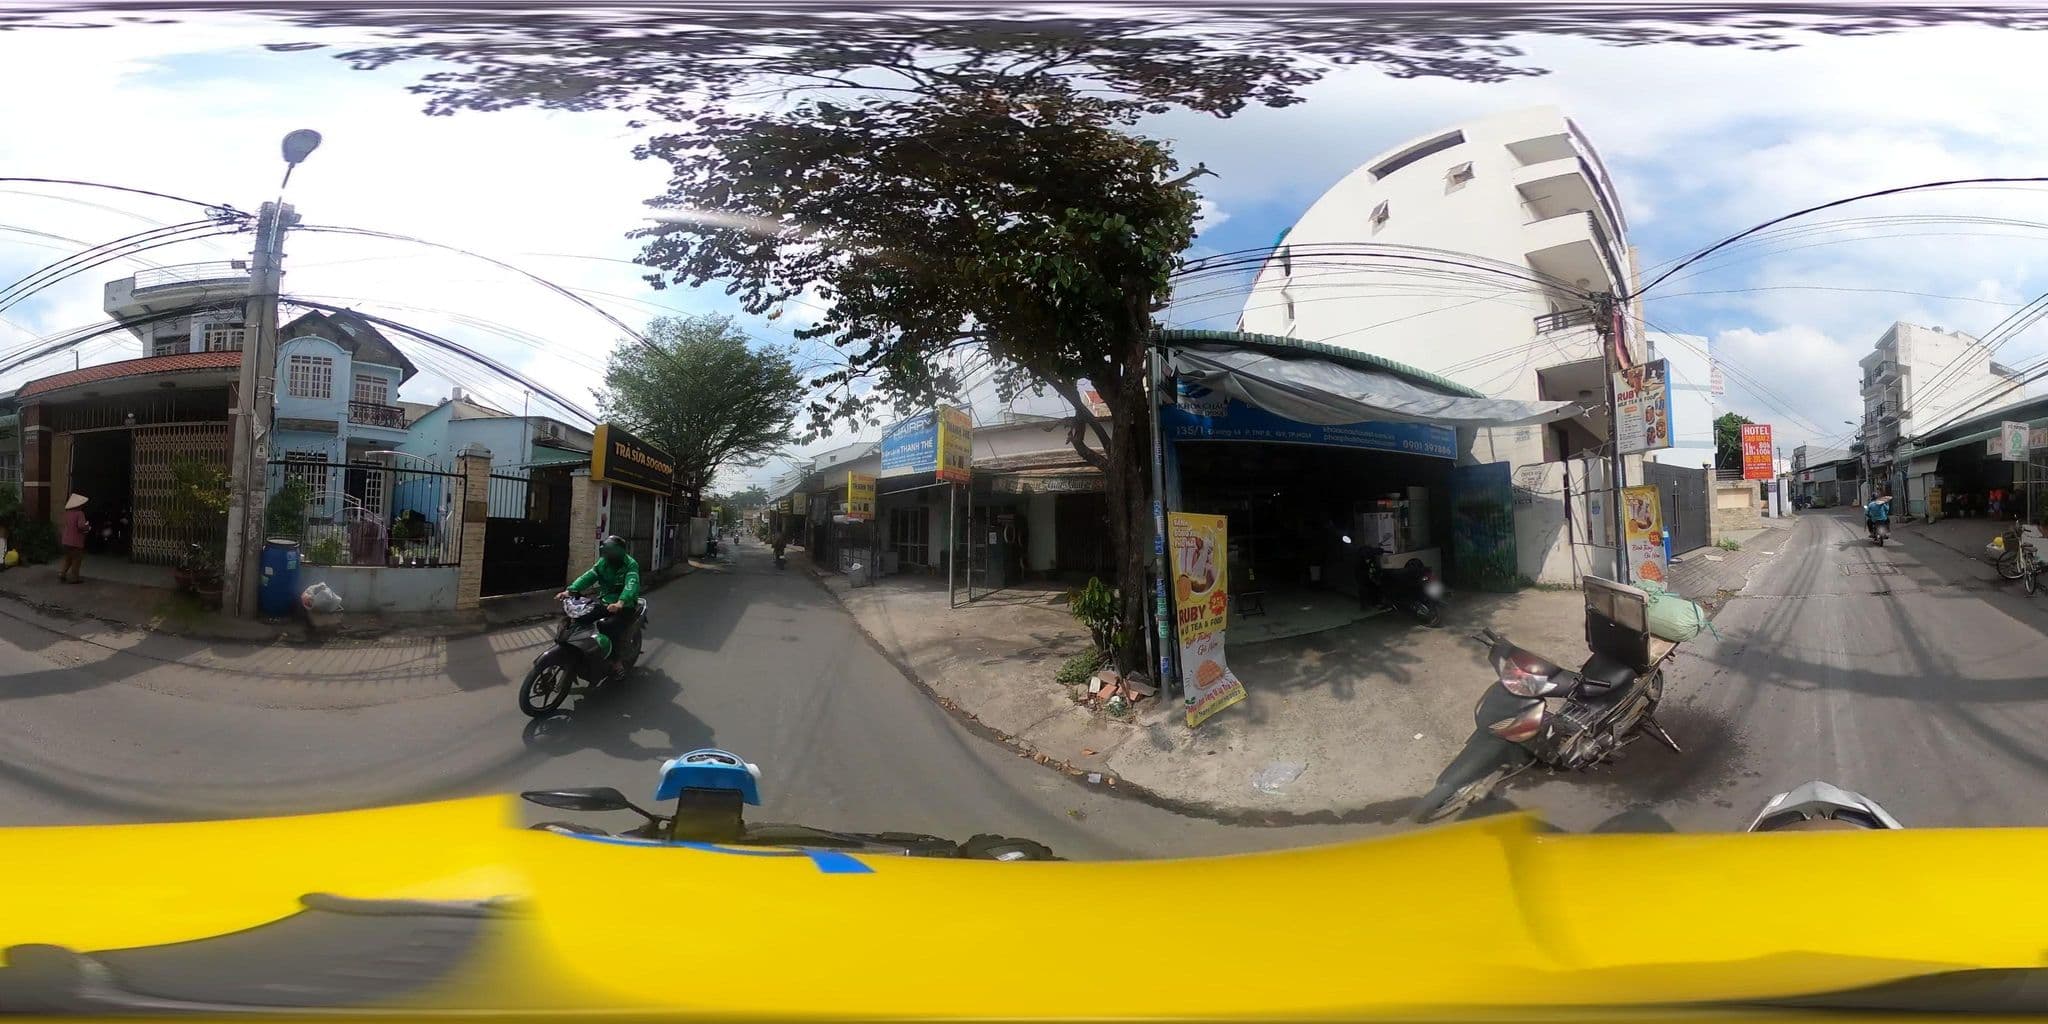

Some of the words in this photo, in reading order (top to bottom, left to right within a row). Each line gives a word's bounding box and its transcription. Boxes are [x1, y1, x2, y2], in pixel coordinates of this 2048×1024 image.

[1744, 426, 1770, 435] HOTEL
[900, 442, 920, 453] THANH
[1179, 605, 1205, 625] RUBY
[1191, 622, 1203, 631] TEA
